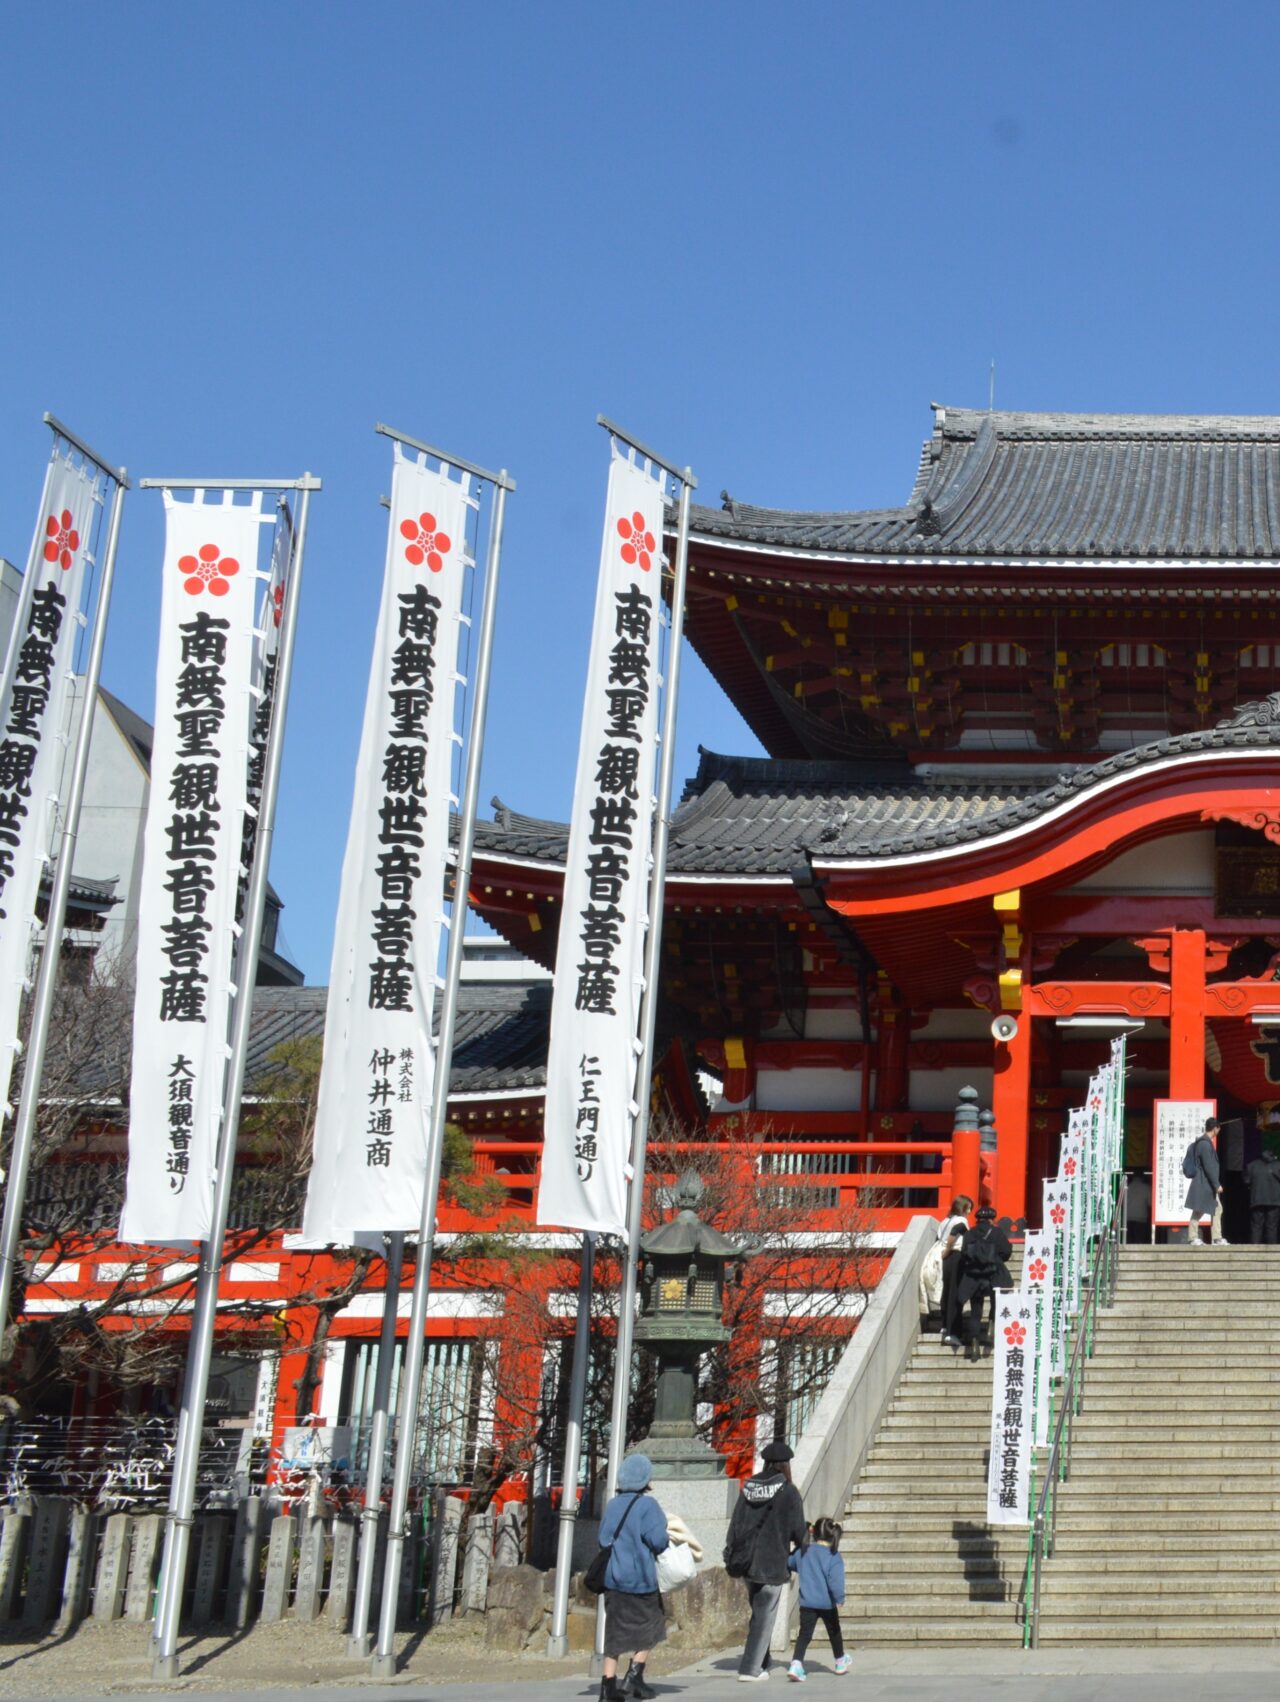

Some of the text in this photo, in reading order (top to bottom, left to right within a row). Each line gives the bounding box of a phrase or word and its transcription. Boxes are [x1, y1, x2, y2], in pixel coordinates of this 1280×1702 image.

[159, 611, 231, 1023] 南無聖観世音菩薩
[368, 583, 442, 1012] 南無聖観世音菩薩
[575, 583, 652, 1016] 南無聖観世音菩薩
[166, 1054, 196, 1195] 大須観音通り
[366, 1047, 396, 1168] 仲井通商
[397, 1047, 414, 1103] 株式会社
[575, 1054, 602, 1182] 仁王門通り
[1027, 1246, 1051, 1257] 奉納
[1047, 1192, 1068, 1202] 奉納
[1000, 1306, 1032, 1320] 奉納
[999, 1346, 1025, 1509] 南無聖観世音菩薩
